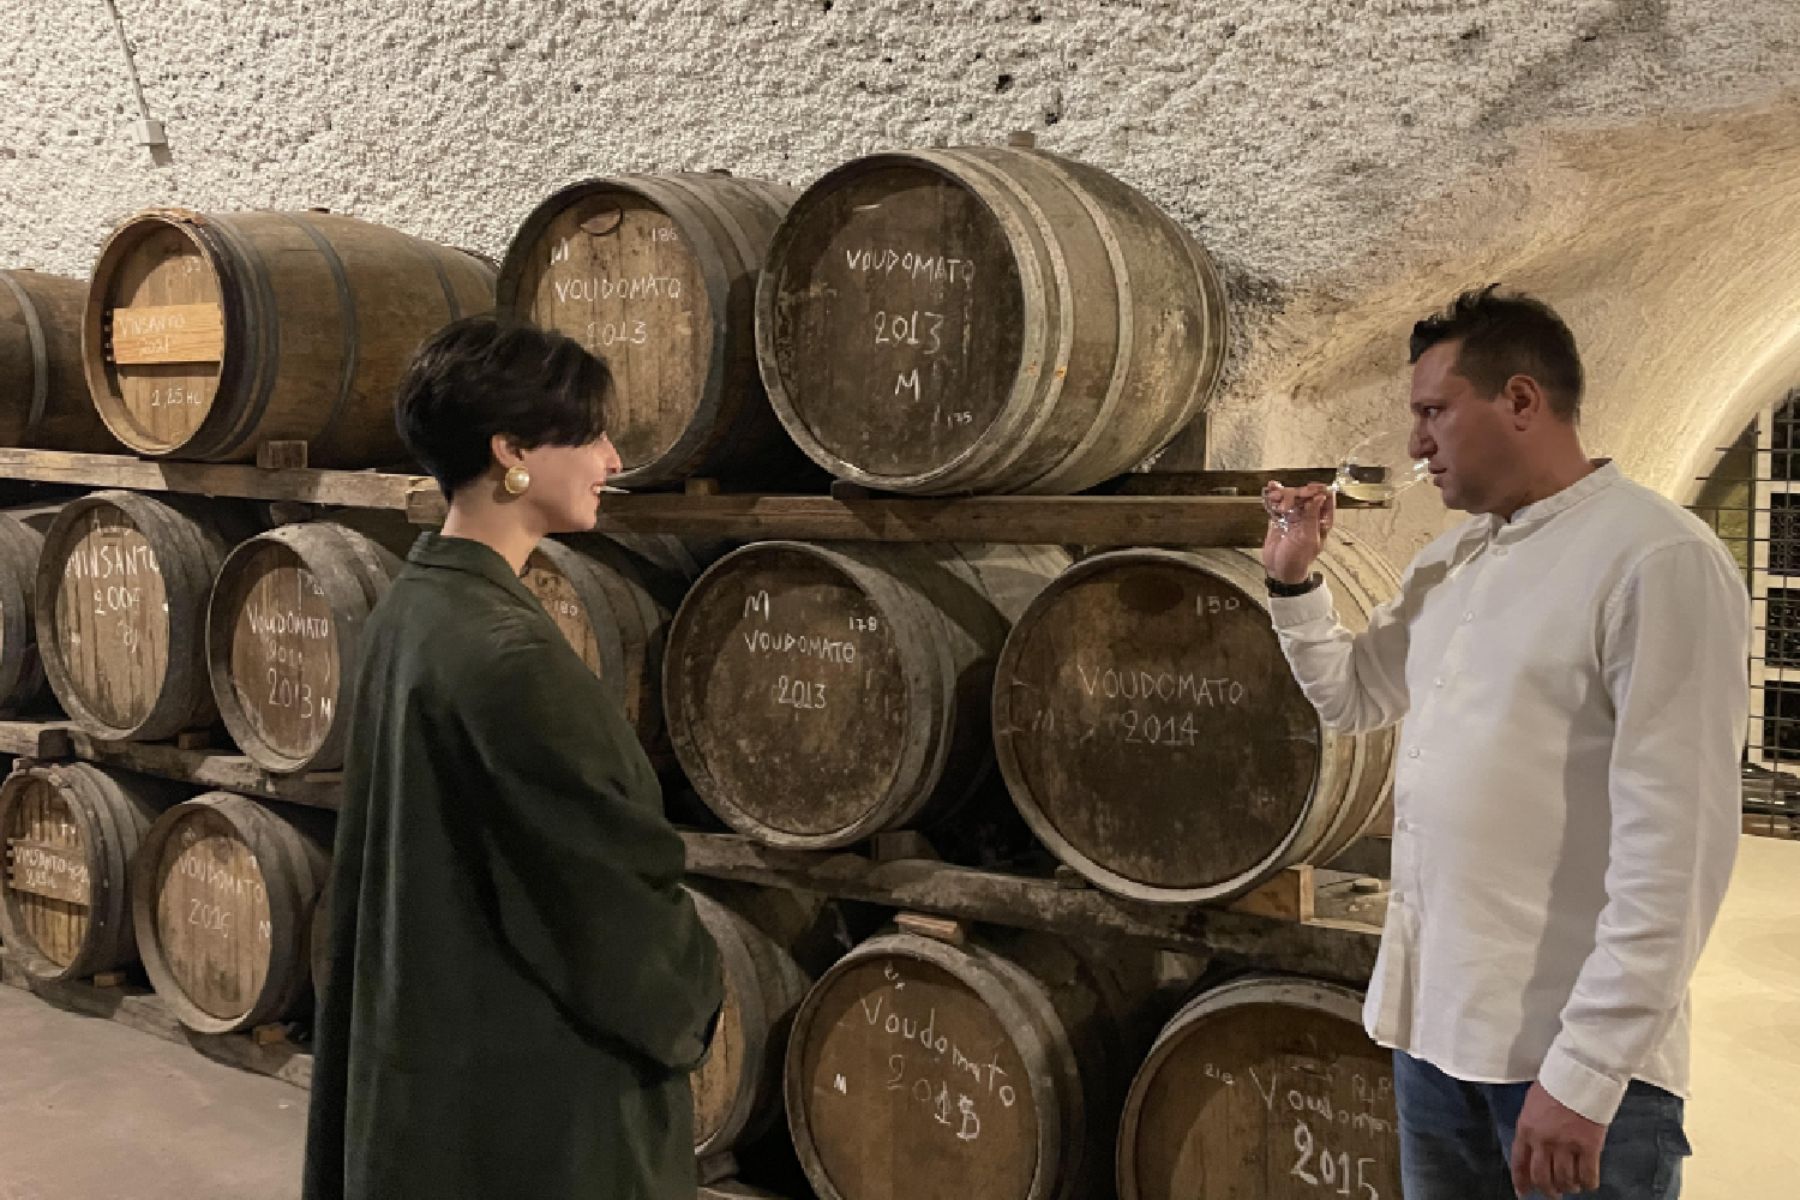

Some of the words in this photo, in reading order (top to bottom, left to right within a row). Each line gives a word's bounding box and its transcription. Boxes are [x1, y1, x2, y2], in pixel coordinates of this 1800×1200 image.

[847, 249, 975, 285] VOUDOMATO
[555, 273, 682, 303] VOUDOMATO
[587, 320, 648, 349] 2013
[875, 310, 944, 355] 2013
[895, 367, 920, 403] M
[744, 590, 770, 621] M
[1195, 595, 1241, 617] 150
[744, 629, 856, 663] VOUDOMATO
[778, 675, 827, 709] 2013
[1077, 664, 1243, 707] VOUDOMATO
[1119, 709, 1200, 747] 2014
[1291, 1119, 1379, 1200] 2015
